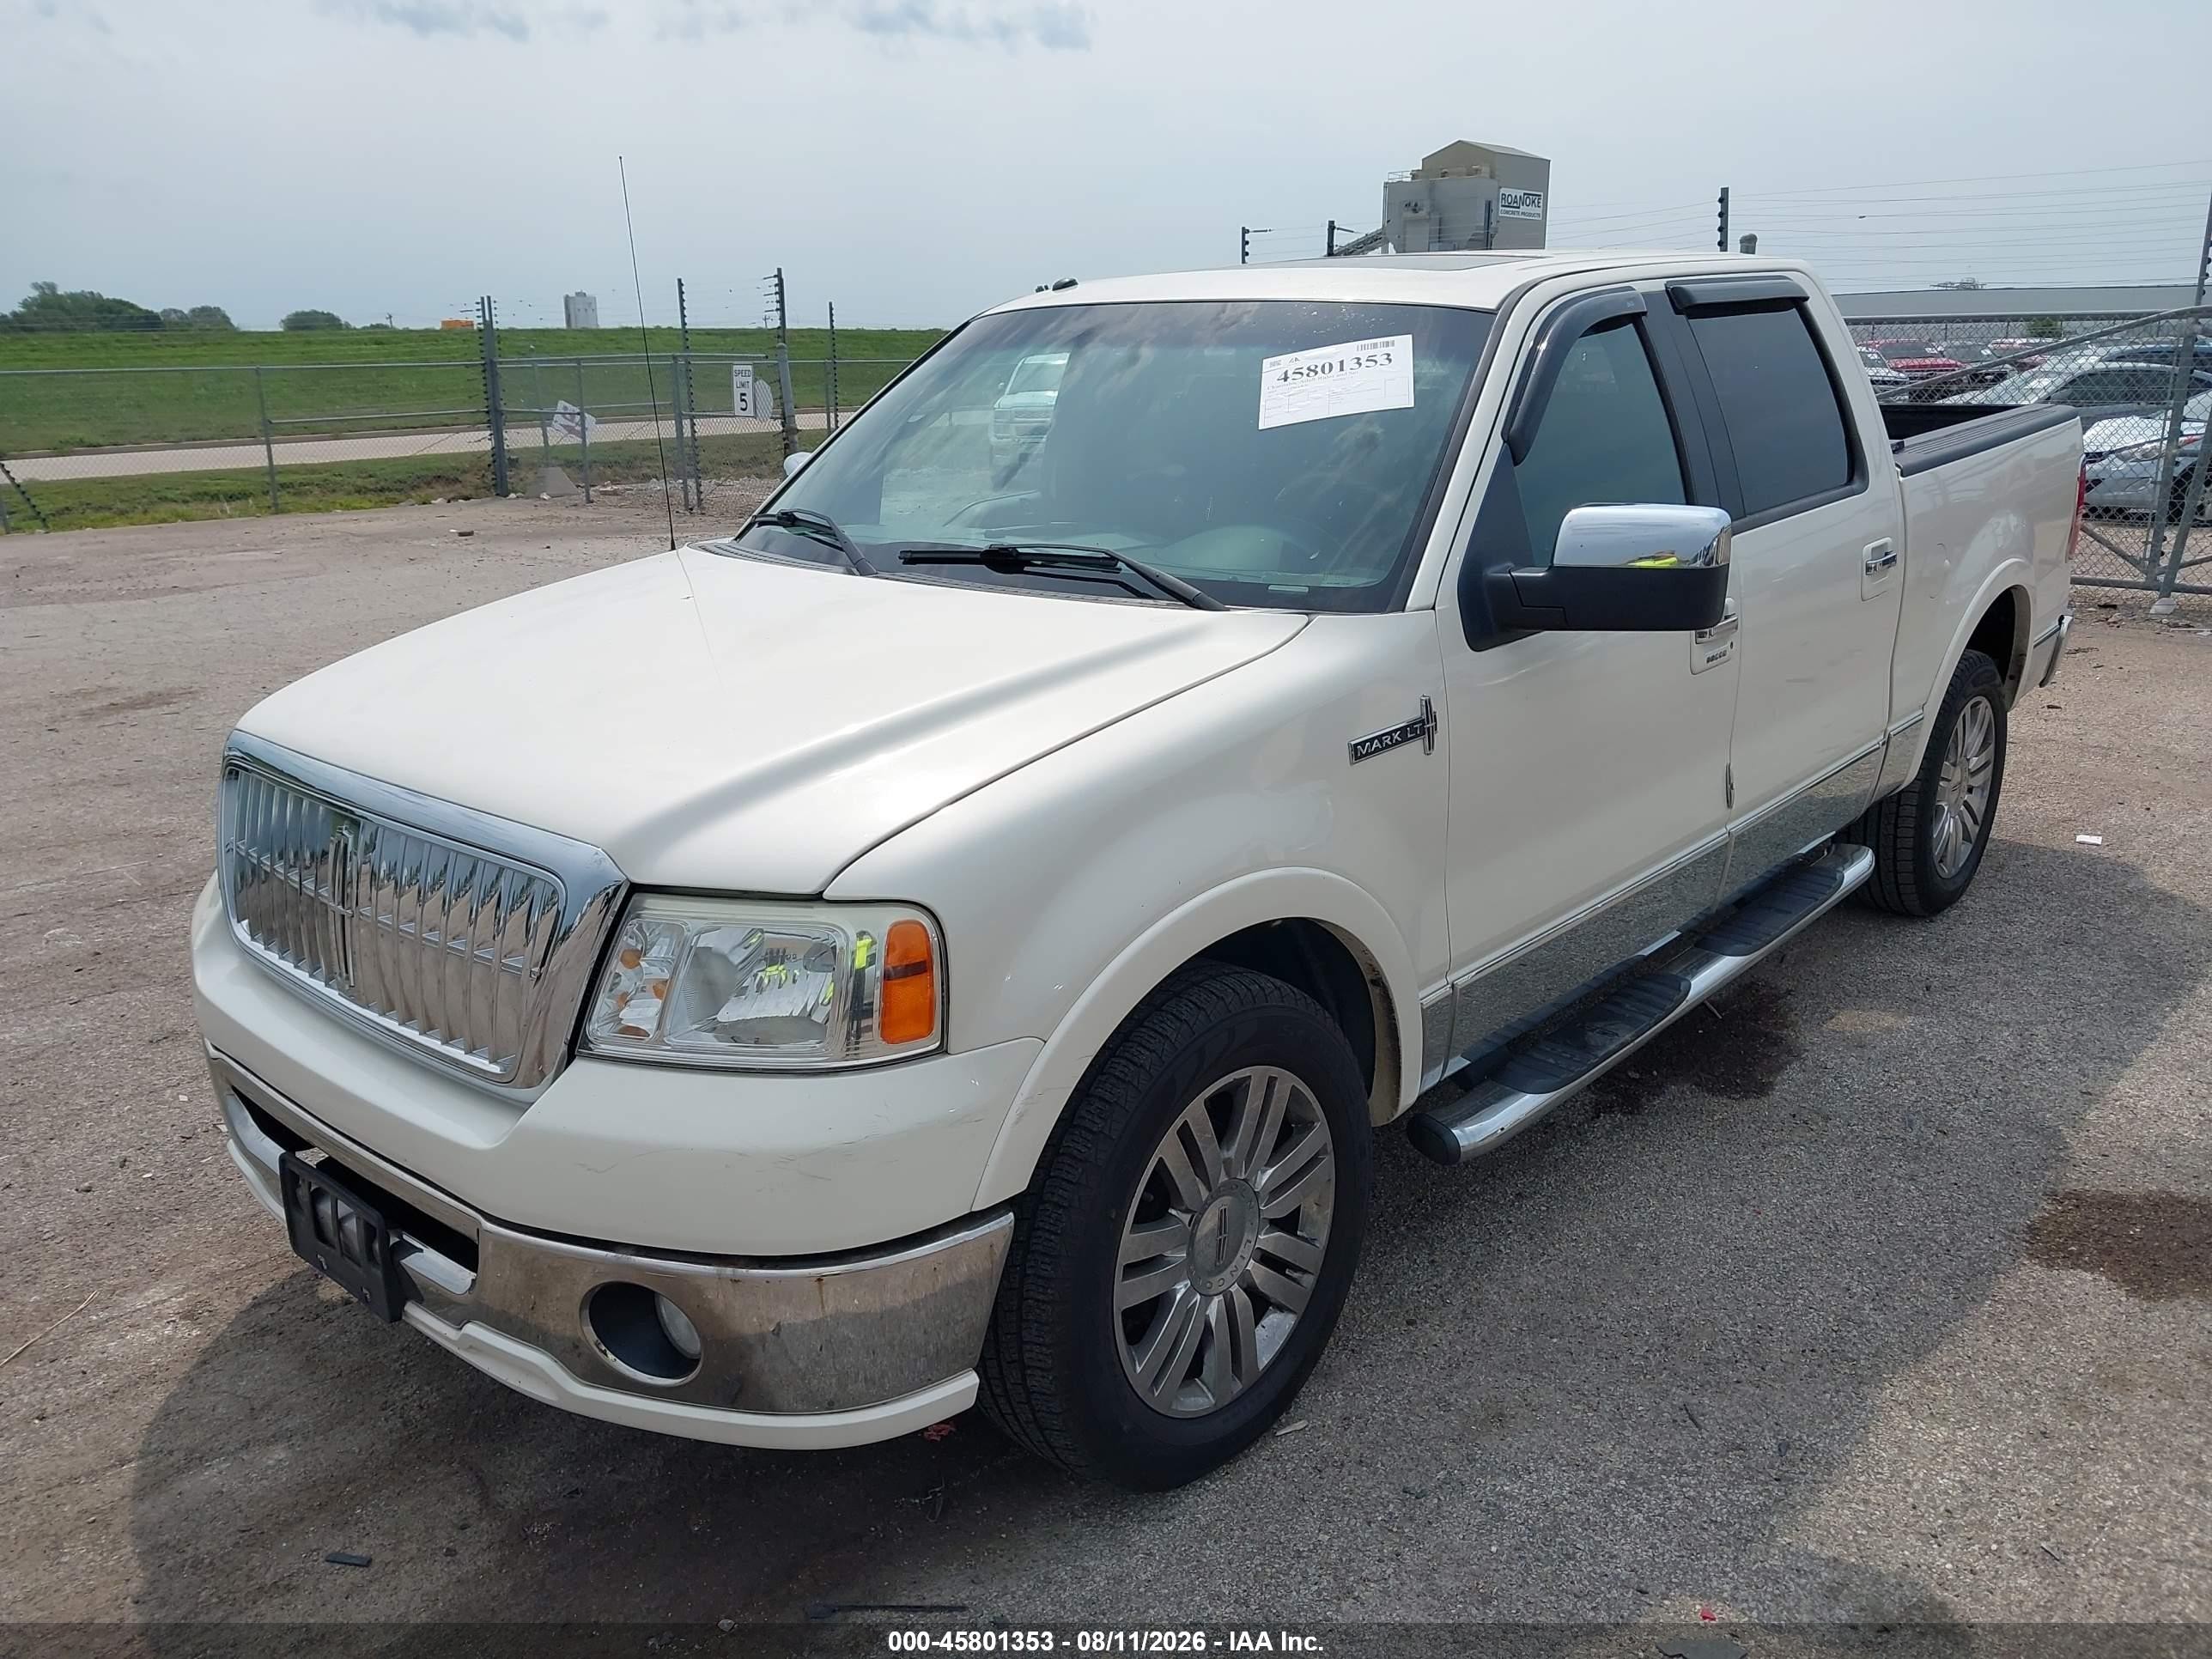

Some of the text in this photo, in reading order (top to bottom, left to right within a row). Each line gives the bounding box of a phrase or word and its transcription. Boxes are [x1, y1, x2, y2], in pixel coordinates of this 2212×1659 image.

[1501, 193, 1541, 209] ROANOKE
[734, 369, 751, 378] SPEED
[1277, 353, 1393, 383] 45801353
[736, 380, 750, 389] LIMIT
[740, 392, 748, 411] 5
[1356, 722, 1423, 757] MARK LT
